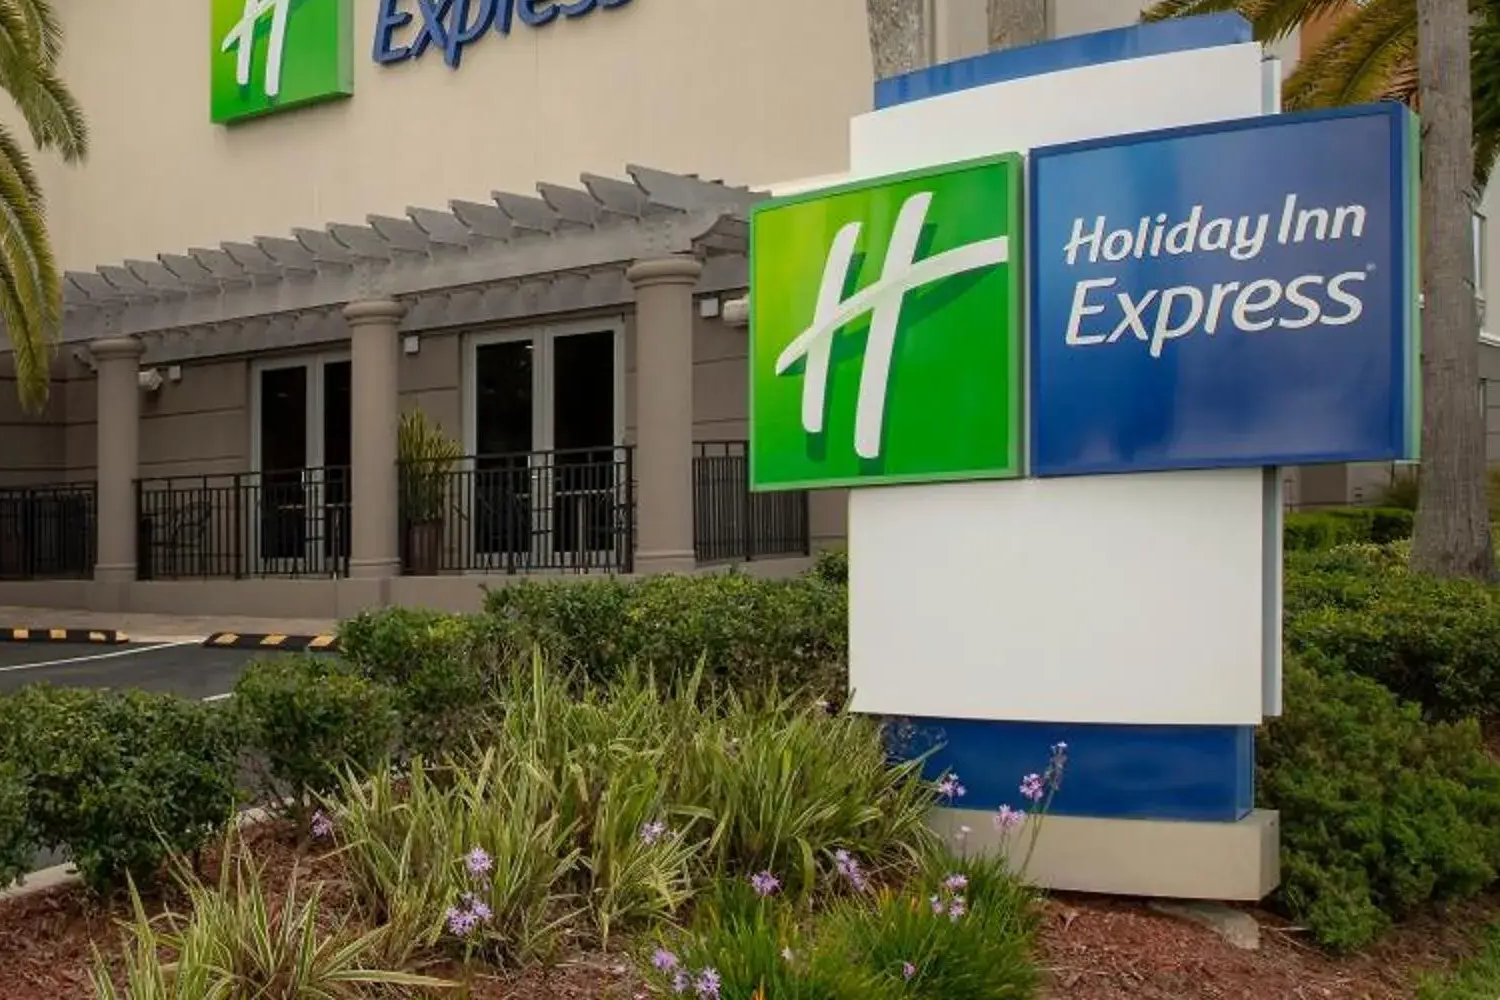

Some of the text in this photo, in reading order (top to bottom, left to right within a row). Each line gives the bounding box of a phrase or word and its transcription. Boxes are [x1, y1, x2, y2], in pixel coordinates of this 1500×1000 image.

[1064, 193, 1366, 264] Holiday Inn
[776, 191, 1008, 459] H
[1065, 271, 1366, 358] Express
